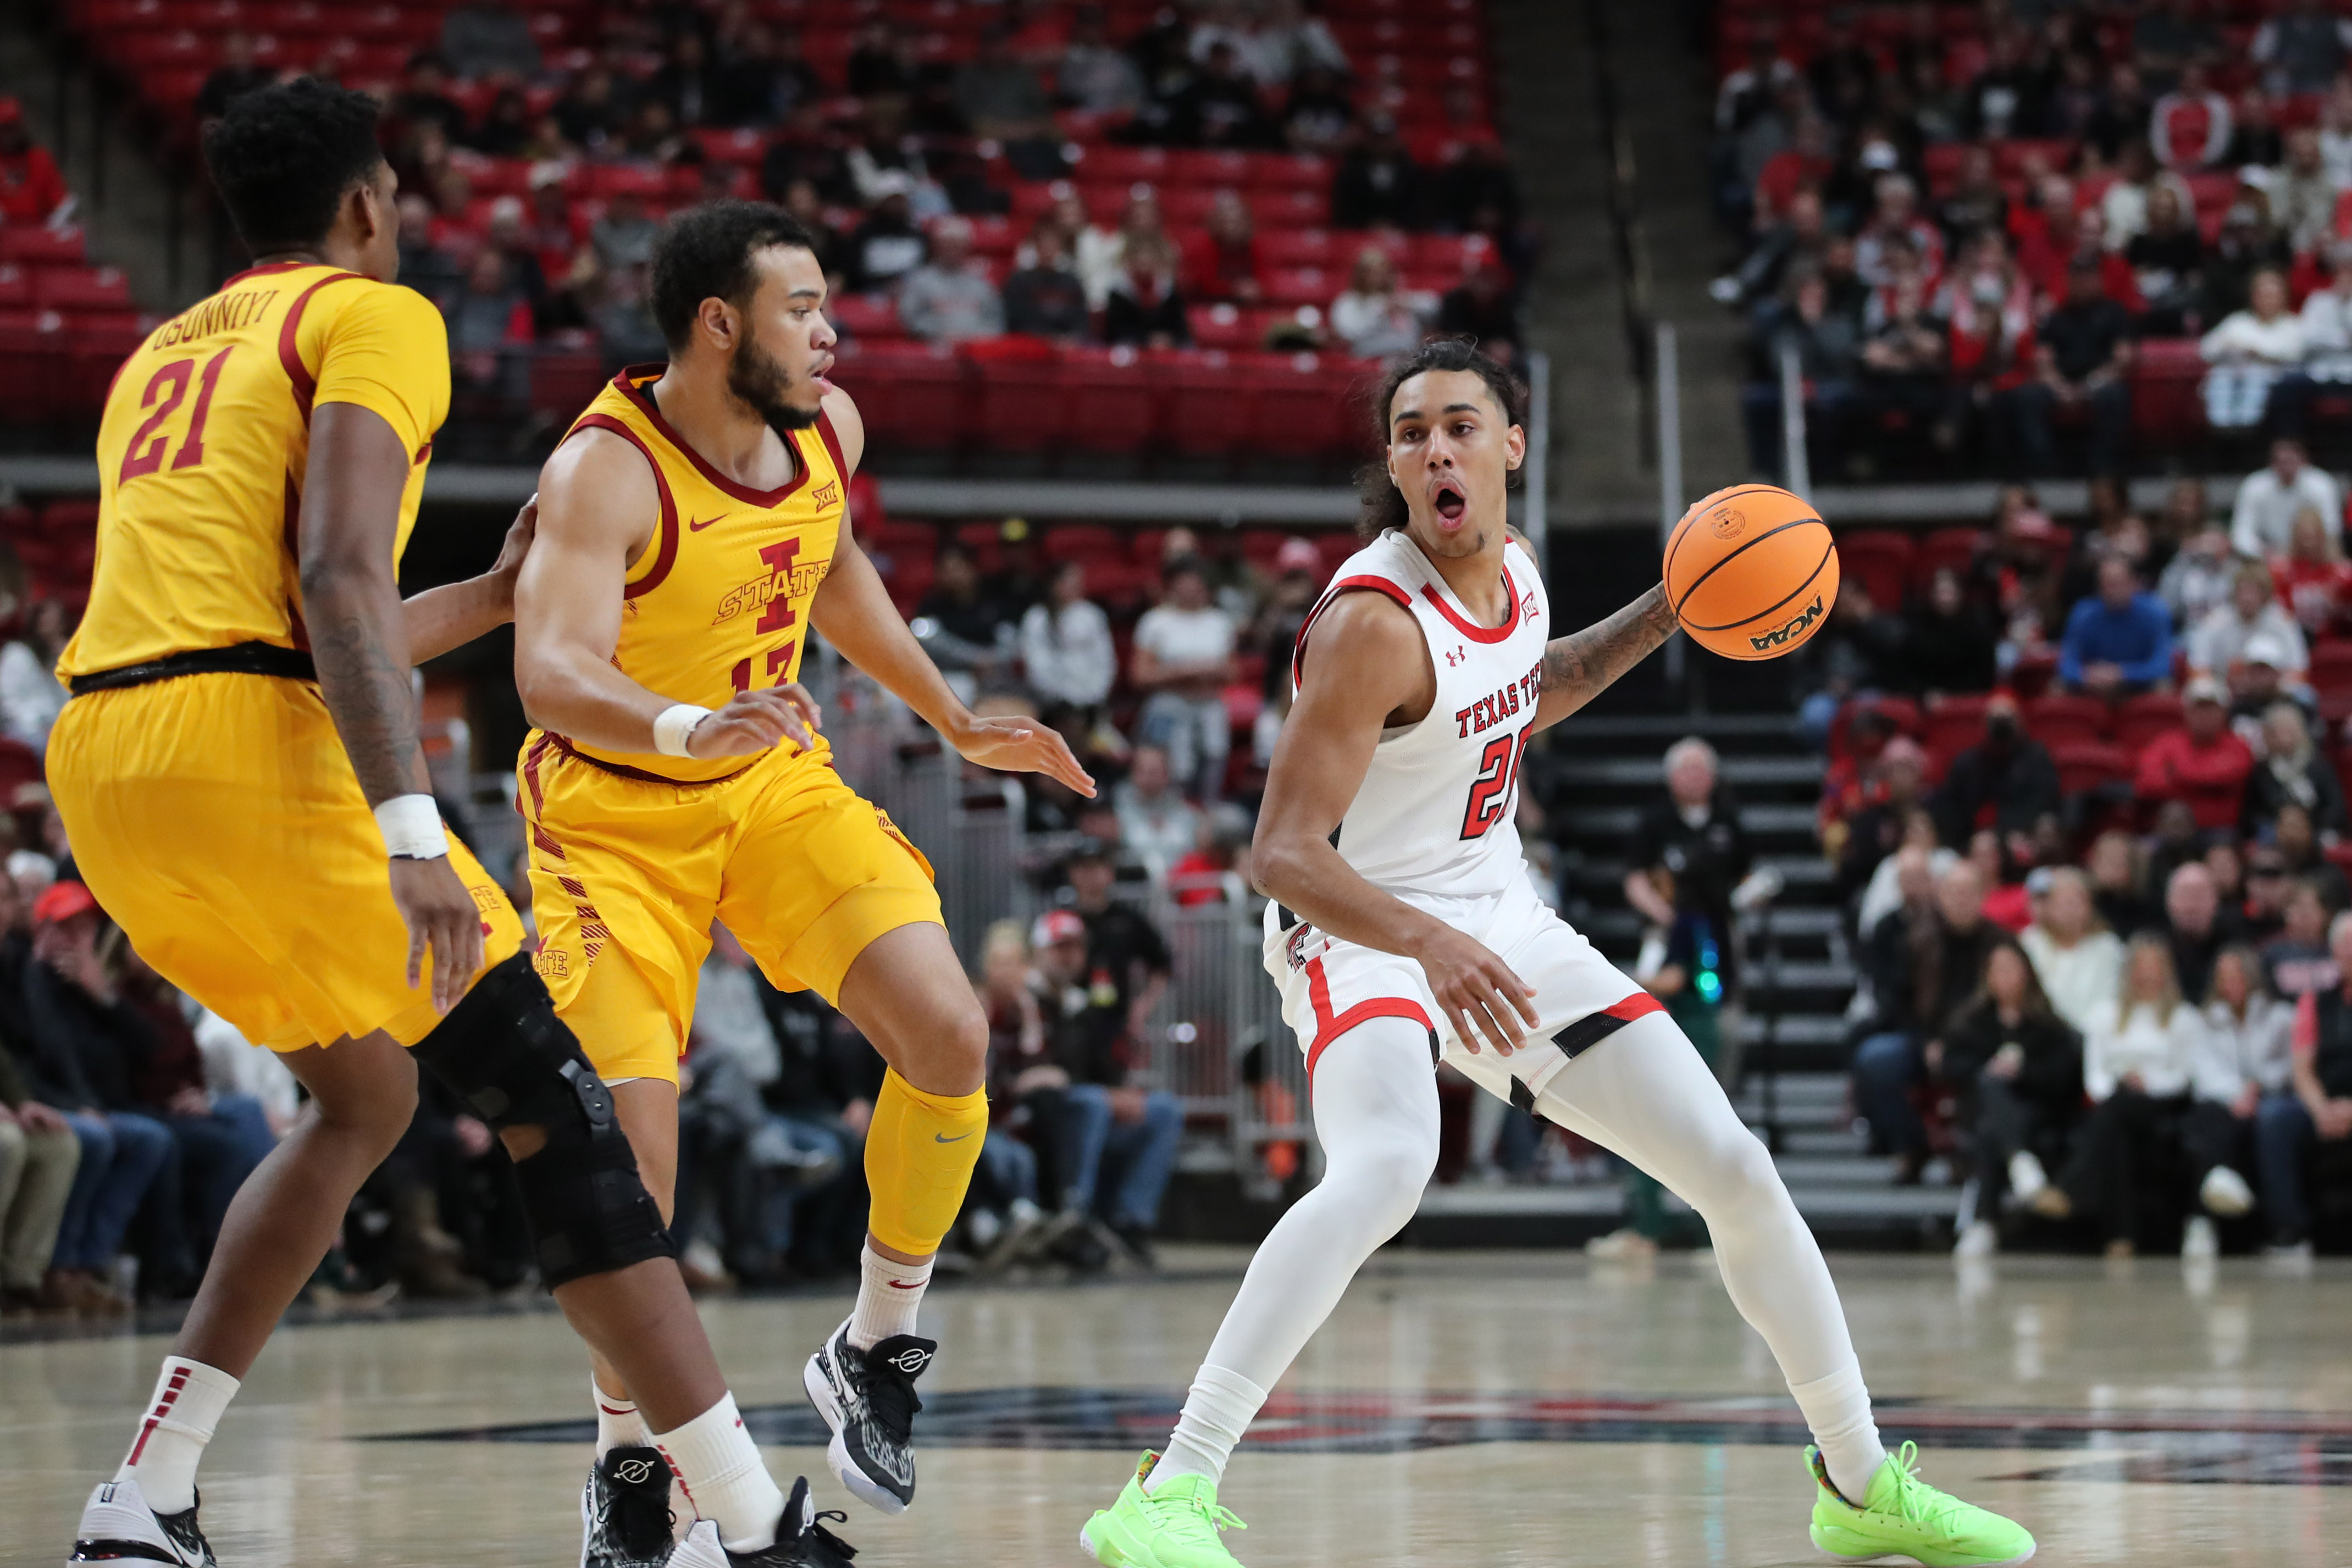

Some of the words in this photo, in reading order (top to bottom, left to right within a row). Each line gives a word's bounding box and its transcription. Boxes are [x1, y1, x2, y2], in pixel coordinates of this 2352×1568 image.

[118, 346, 235, 488] 21
[1748, 595, 1823, 651] NCAA
[1456, 682, 1519, 739] TEXAS
